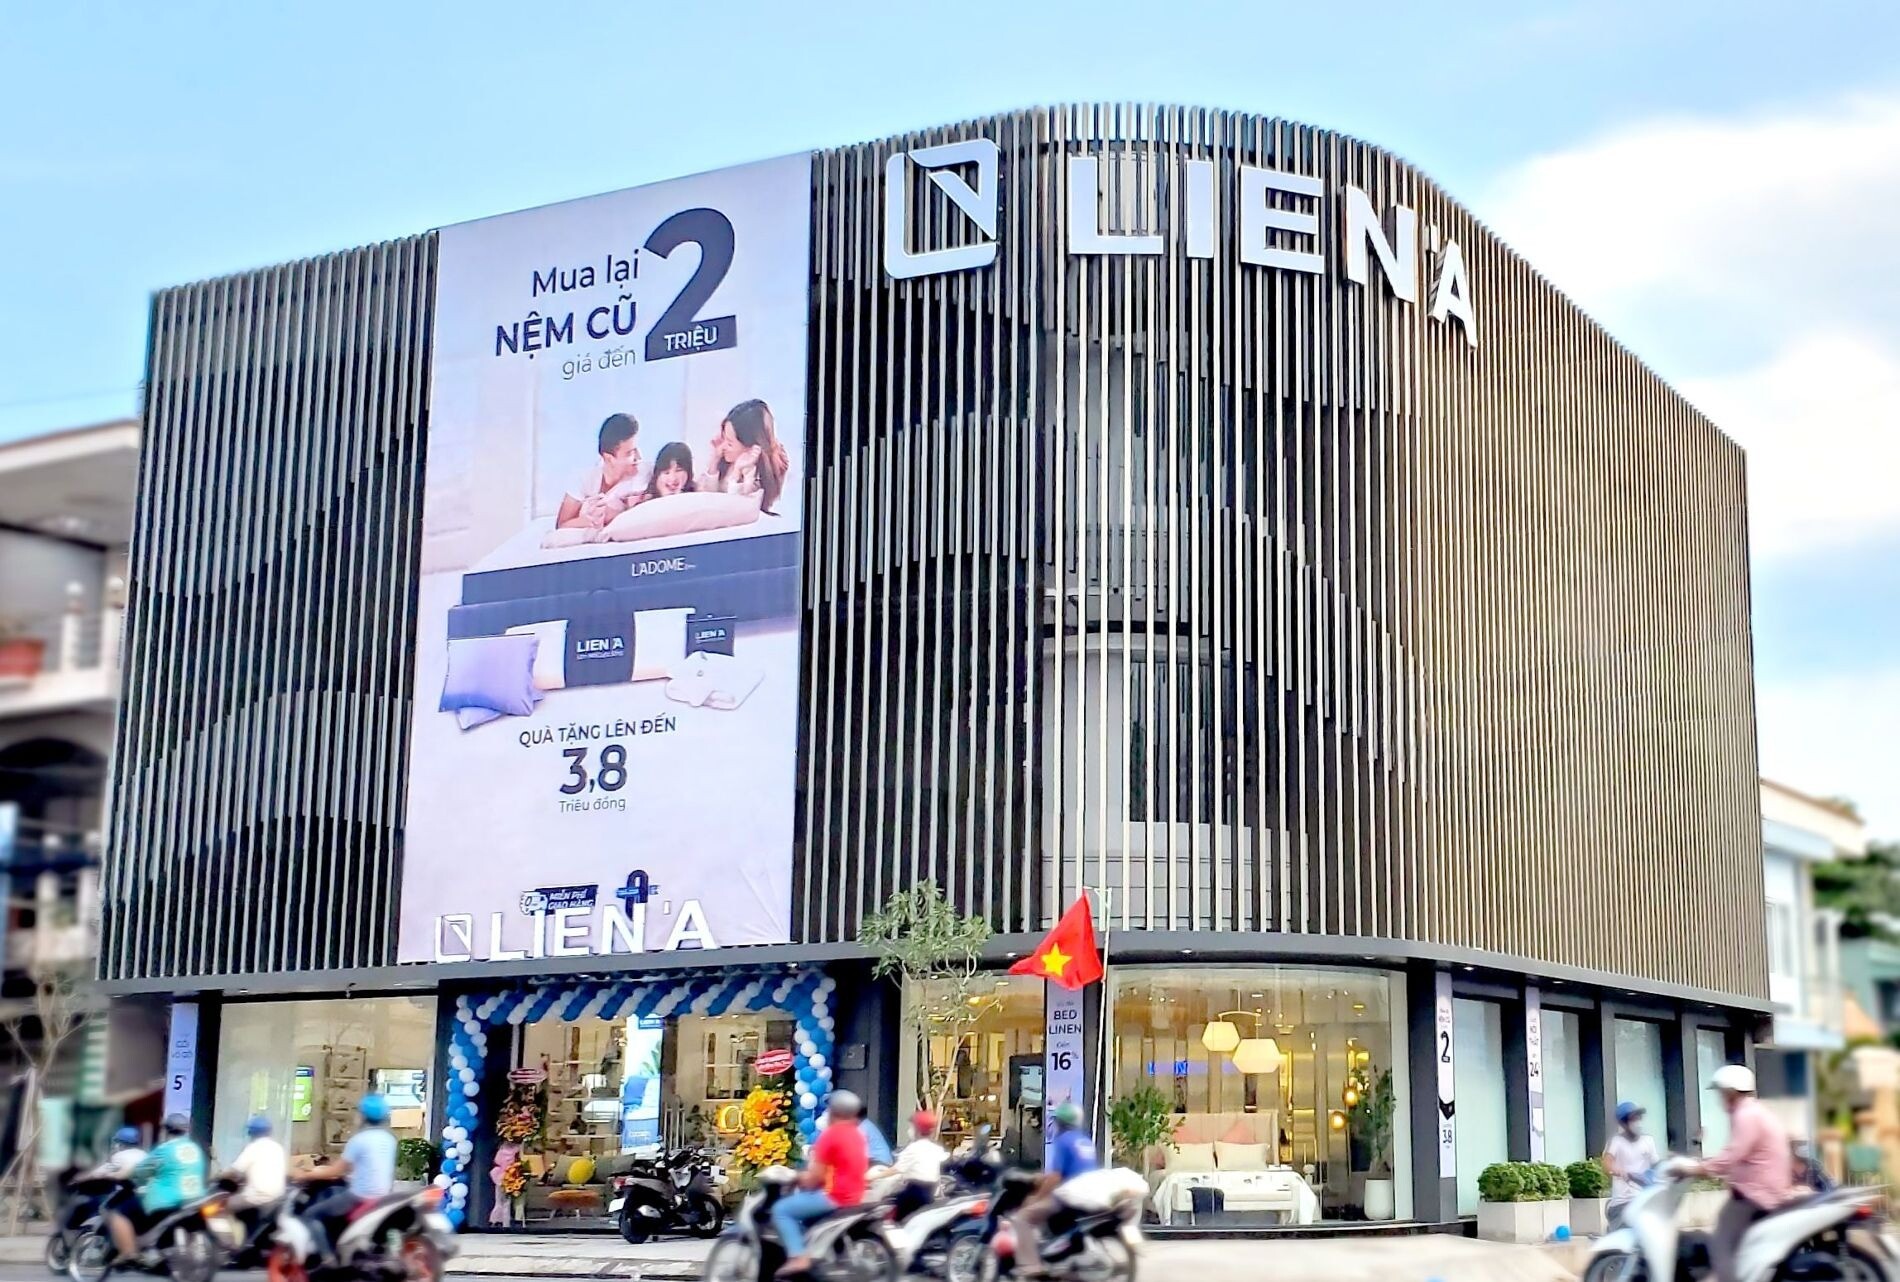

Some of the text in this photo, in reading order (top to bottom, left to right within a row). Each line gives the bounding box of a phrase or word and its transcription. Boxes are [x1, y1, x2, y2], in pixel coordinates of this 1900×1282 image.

[532, 248, 640, 298] Mua lại
[643, 207, 737, 361] 2
[495, 292, 637, 360] NỆM CŨ
[663, 325, 718, 351] TRIỆU
[562, 344, 636, 381] giá đến
[519, 712, 676, 748] QUÀ TẶNG LÊN ĐẾN
[559, 744, 628, 795] 3,8
[1049, 1023, 1082, 1035] LINEN
[1053, 1009, 1078, 1020] BED
